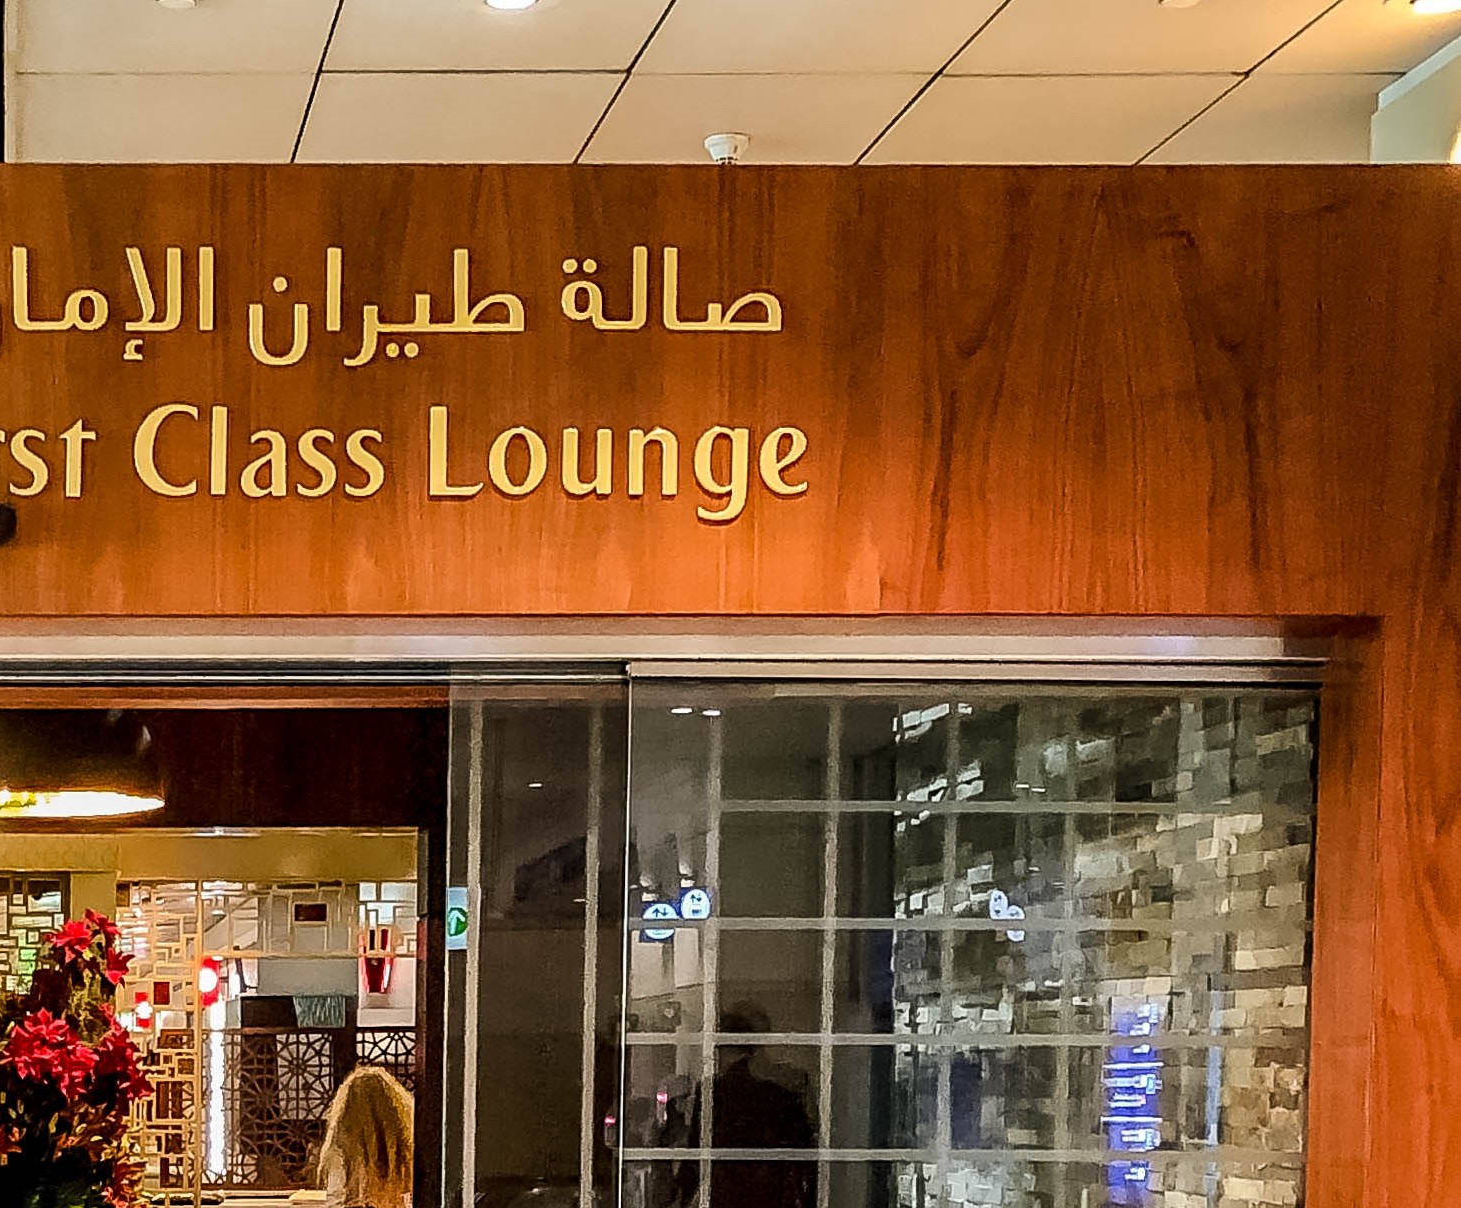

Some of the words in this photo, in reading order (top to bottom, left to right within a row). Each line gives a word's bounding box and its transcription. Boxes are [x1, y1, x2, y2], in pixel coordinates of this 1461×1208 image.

[248, 246, 526, 368] طيران
[561, 246, 783, 333] صالة
[133, 403, 386, 498] Class
[428, 405, 809, 522] Lounge
